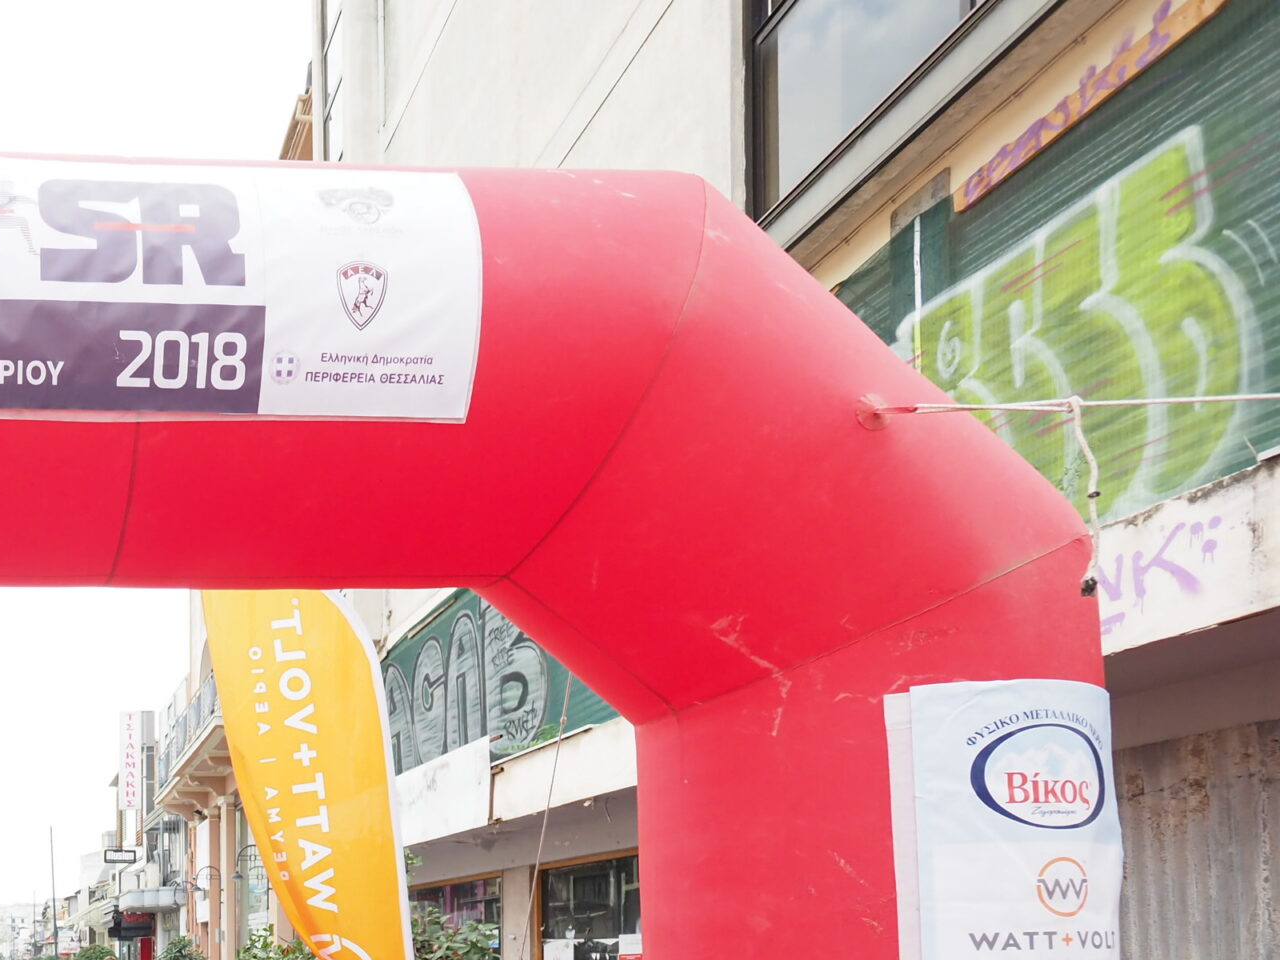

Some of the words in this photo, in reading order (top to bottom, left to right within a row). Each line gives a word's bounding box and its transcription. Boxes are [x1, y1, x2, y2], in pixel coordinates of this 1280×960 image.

[38, 178, 246, 287] SR
[116, 330, 246, 390] 2018
[304, 370, 376, 387] ΠΕΡΙΦΕΡΕΙΑ
[379, 371, 445, 388] ΘΕΣΣΑΛΙΑΣ
[320, 350, 368, 369] Ελληνική
[371, 351, 434, 368] Δημοκρατία
[966, 713, 1020, 747] ΦΥΣΙΚΟ
[1023, 708, 1089, 729] ΜΕΤΑΛΛΙΚΟ
[1004, 771, 1091, 811] Βίκος
